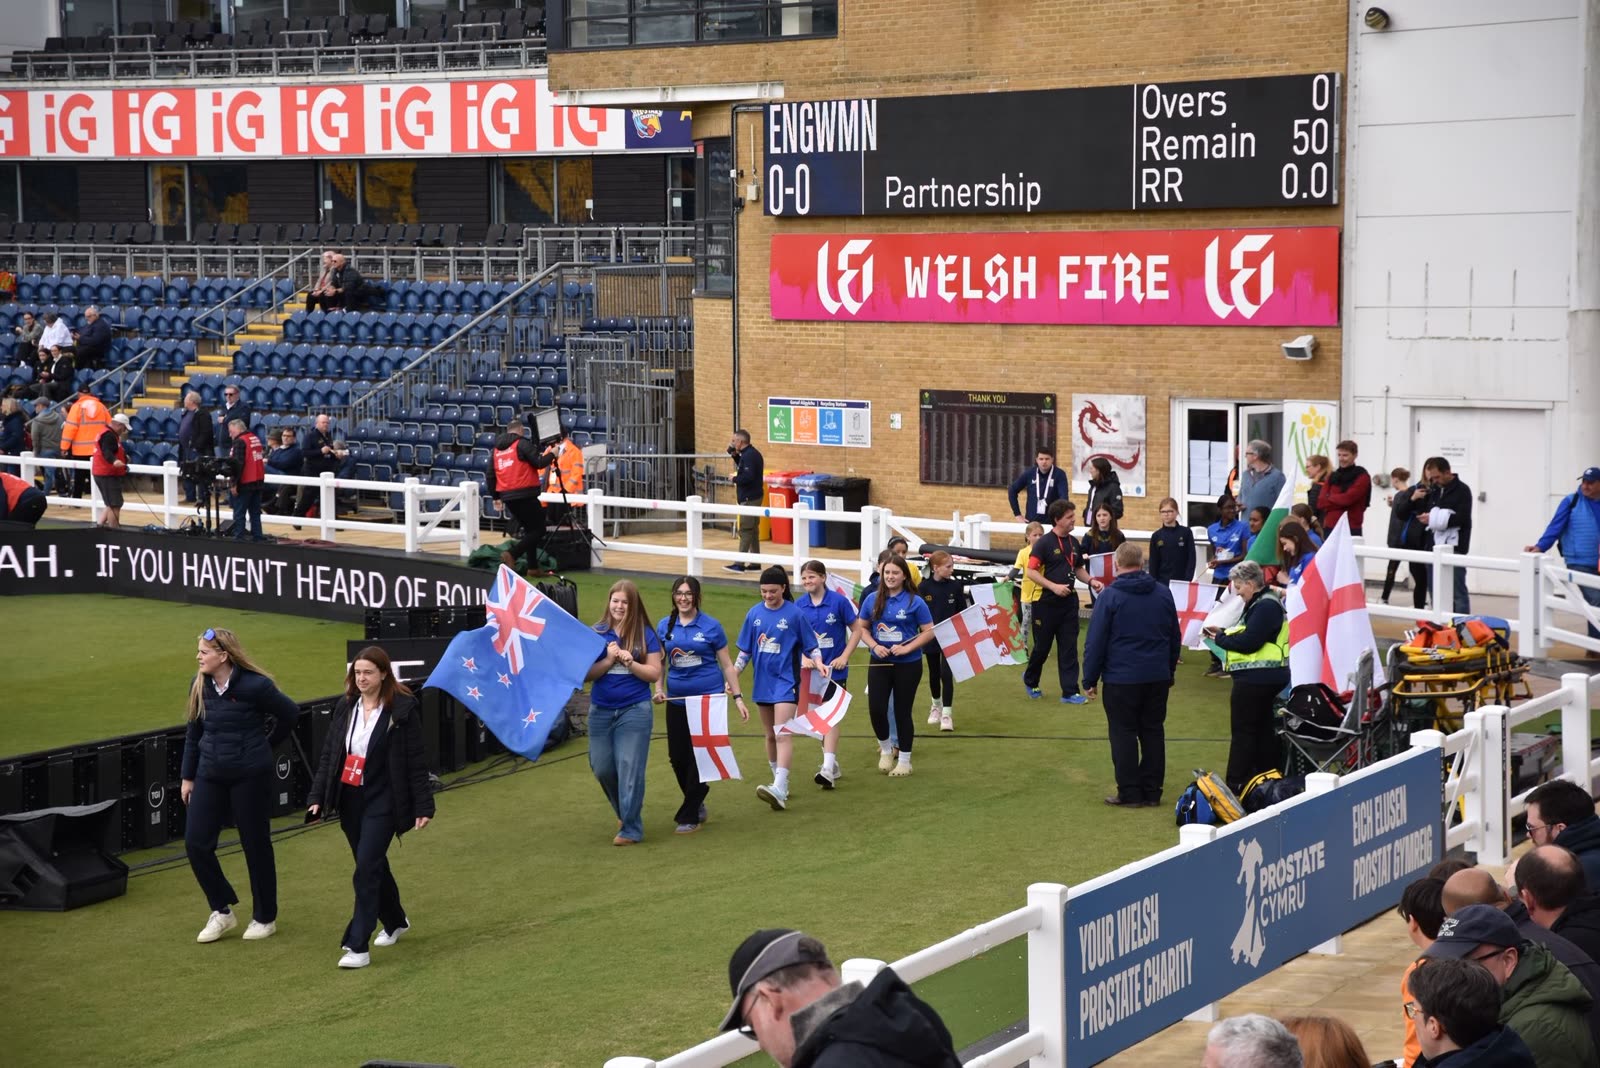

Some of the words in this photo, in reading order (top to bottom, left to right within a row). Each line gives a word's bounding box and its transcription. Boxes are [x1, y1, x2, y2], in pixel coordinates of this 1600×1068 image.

[1142, 84, 1227, 119] Overs
[1312, 74, 1330, 111] 0
[769, 98, 877, 155] ENGWMN
[1142, 122, 1256, 161] Remain
[1292, 118, 1329, 156] 50
[769, 164, 810, 215] 0-0
[886, 172, 1041, 212] Partnership
[1142, 167, 1183, 203] RR
[1281, 162, 1328, 199] 0.0
[904, 253, 1037, 304] WELSH
[1059, 253, 1170, 304] FIRE
[968, 393, 991, 402] THANK
[993, 395, 1006, 403] YOU
[96, 543, 121, 577] IF
[127, 546, 173, 584] YOU
[182, 552, 288, 597] HAVEN'T
[296, 563, 386, 609] HEARD
[394, 575, 427, 608] OF
[1352, 799, 1373, 847] EICH
[1375, 784, 1407, 837] ELUSEN
[1259, 840, 1325, 896] PROSTATE
[1353, 843, 1393, 900] PROSTAT
[1393, 824, 1433, 881] GYMREIG
[1260, 880, 1306, 927] CYMRU
[1079, 913, 1115, 975] YOUR
[1116, 892, 1160, 957] WELSH
[1079, 963, 1142, 1040] PROSTATE
[1143, 938, 1194, 1008] CHARITY
